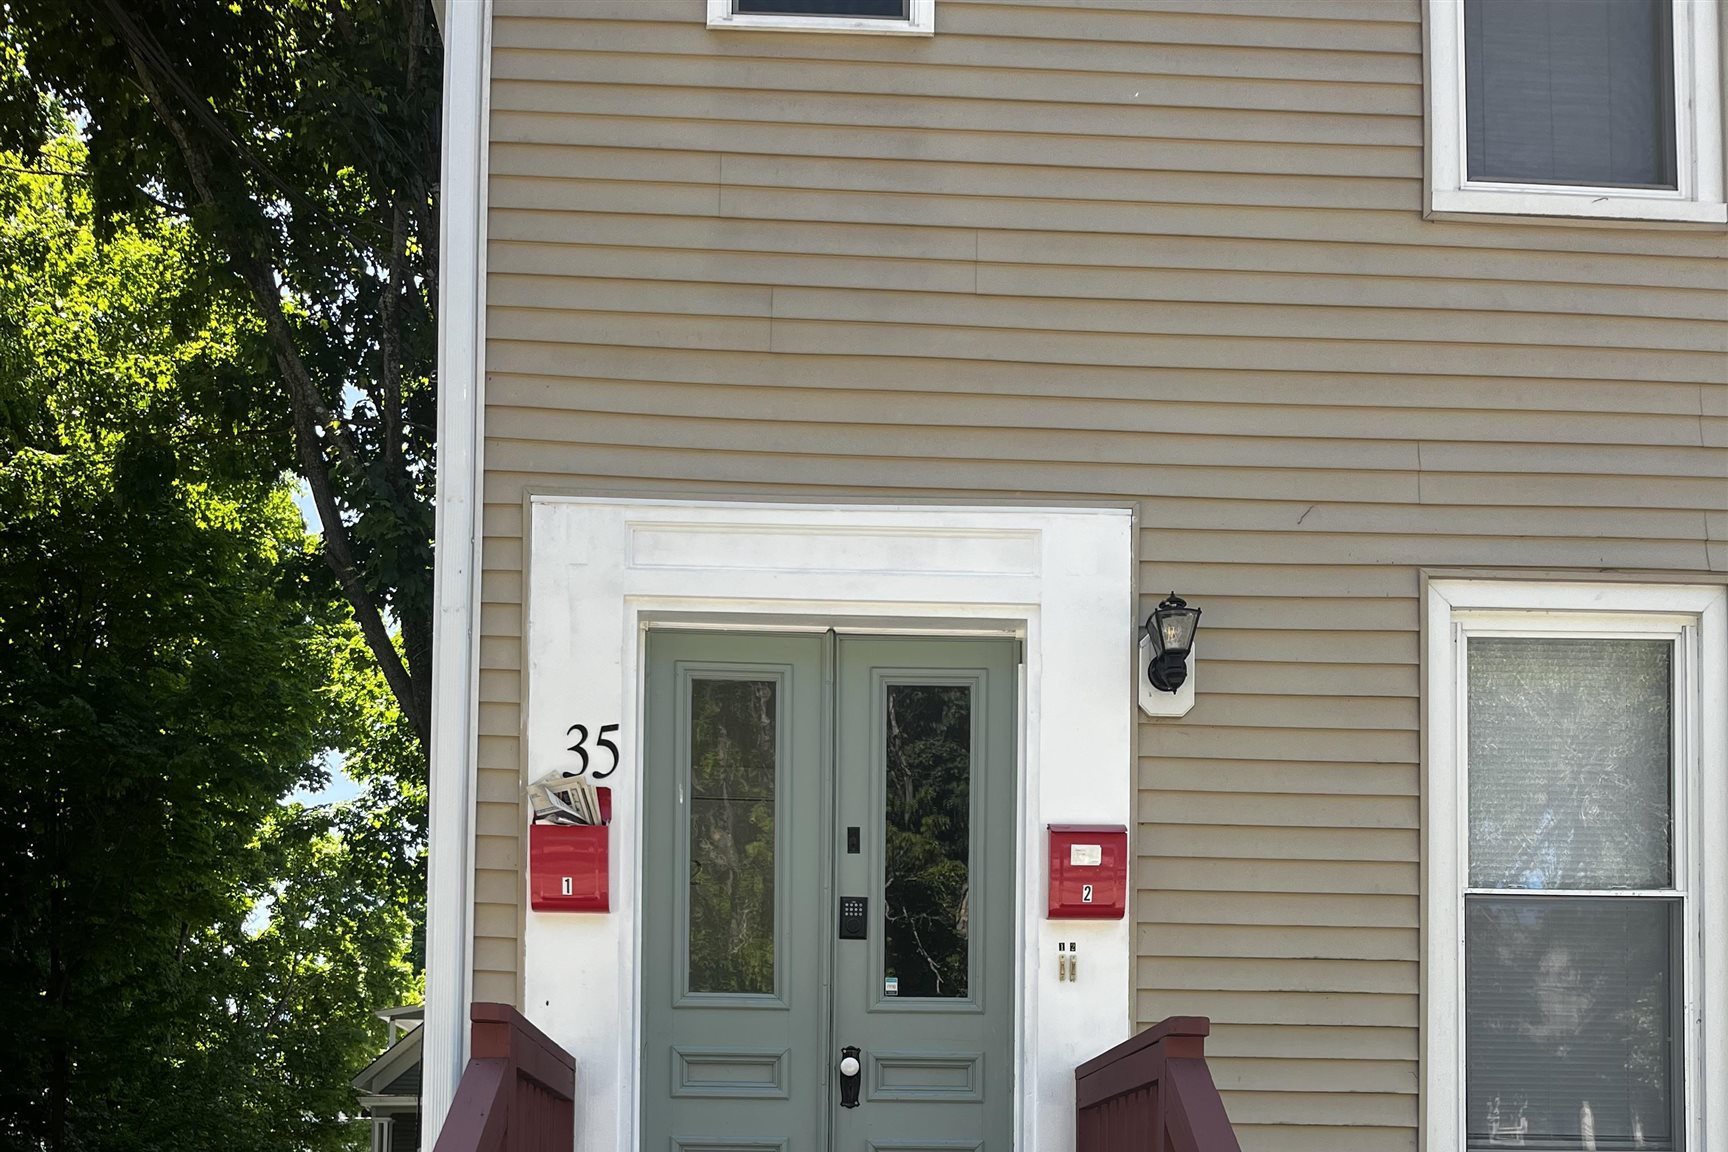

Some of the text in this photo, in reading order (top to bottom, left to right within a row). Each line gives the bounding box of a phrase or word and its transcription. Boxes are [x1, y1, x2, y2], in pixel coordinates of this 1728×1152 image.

[562, 723, 619, 779] 35
[564, 878, 571, 894] 1
[1083, 885, 1091, 901] 2
